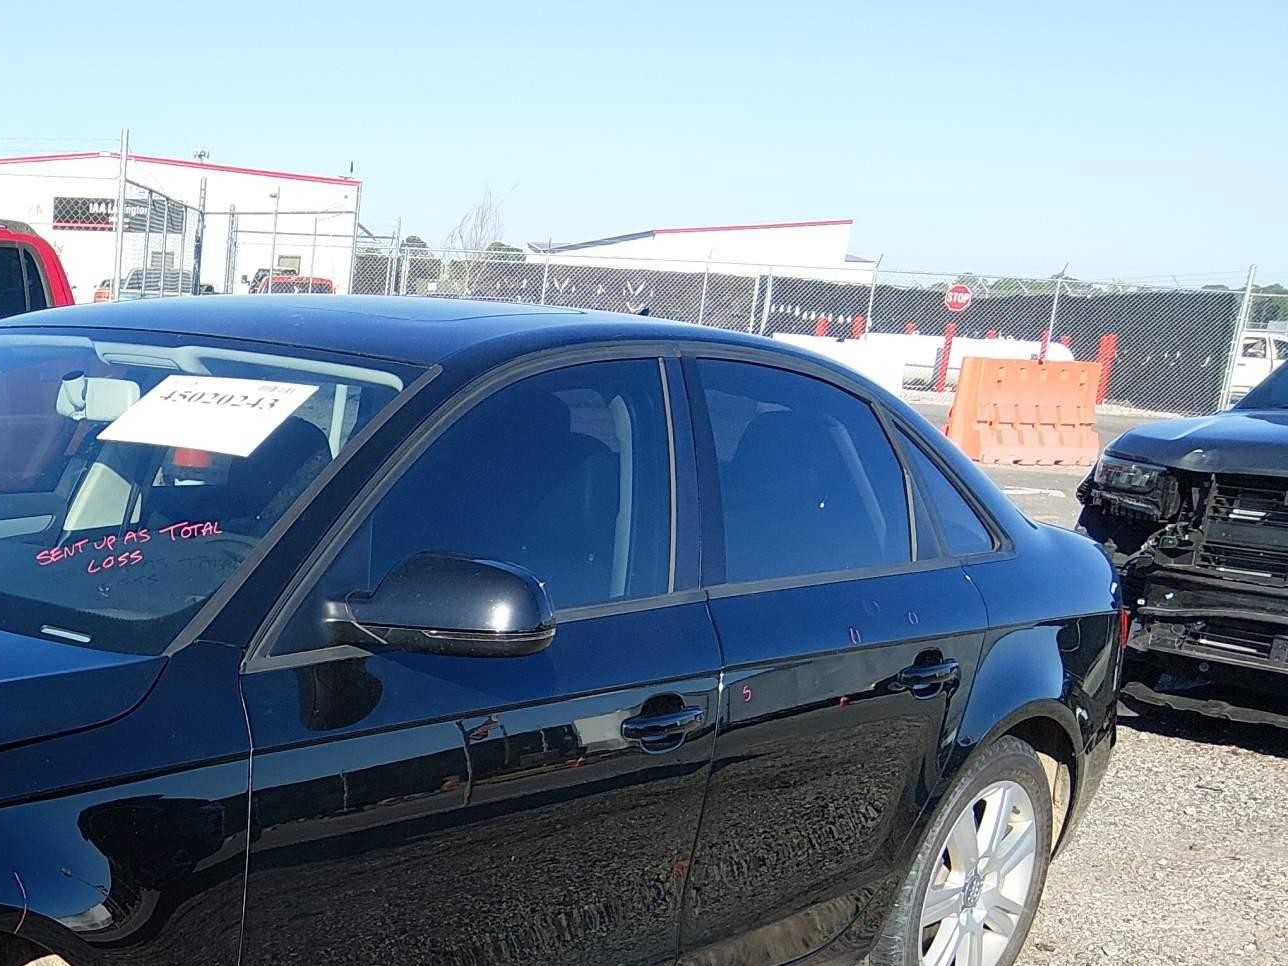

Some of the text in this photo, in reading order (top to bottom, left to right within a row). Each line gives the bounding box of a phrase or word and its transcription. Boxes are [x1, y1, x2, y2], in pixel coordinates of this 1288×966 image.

[89, 202, 106, 214] IAA
[946, 292, 970, 303] STOP
[160, 390, 280, 410] 45020243
[35, 521, 223, 567] SENT UP AS TOTAL
[87, 550, 143, 574] LOSS
